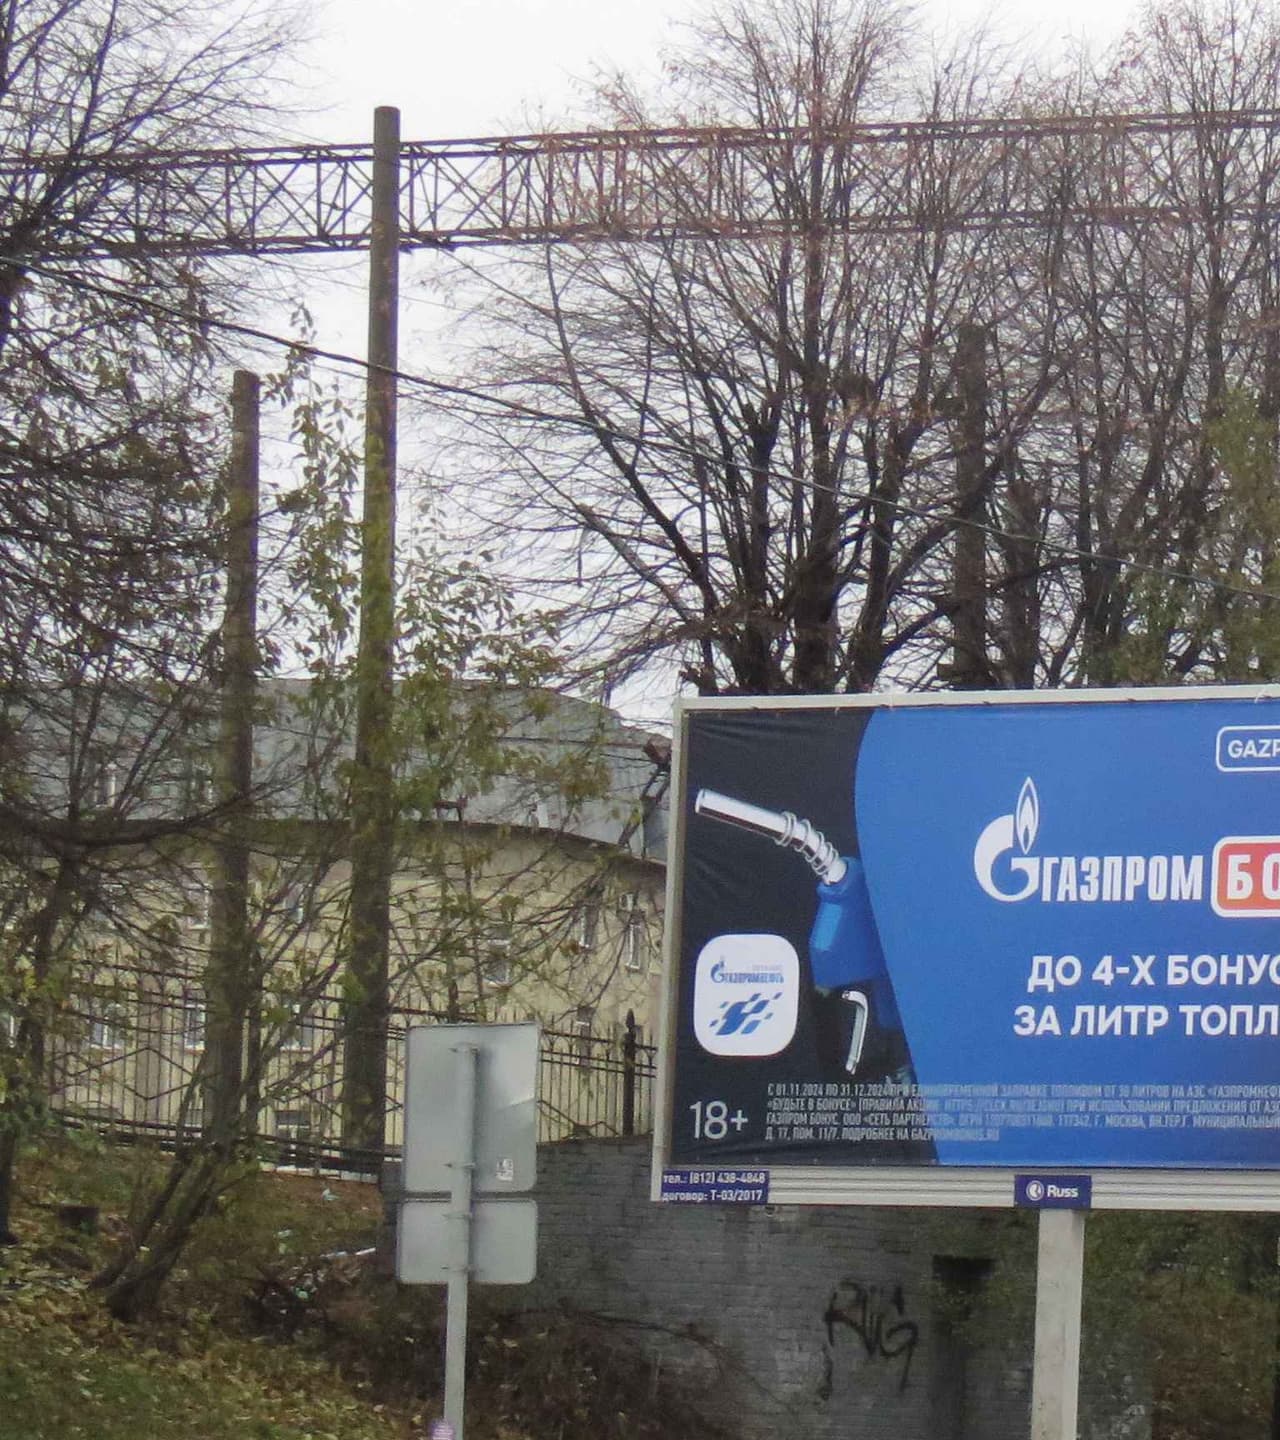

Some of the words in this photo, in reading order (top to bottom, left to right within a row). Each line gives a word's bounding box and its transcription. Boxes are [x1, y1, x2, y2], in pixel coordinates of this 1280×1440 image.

[1041, 855, 1203, 901] ГАЗПРОМ
[1027, 955, 1082, 993] ДО
[1091, 954, 1156, 986] 4-Х
[1013, 1005, 1062, 1036] ЗА
[1070, 1005, 1169, 1036] ЛИТР
[689, 1101, 748, 1139] 18+
[1047, 1185, 1079, 1198] Russ
